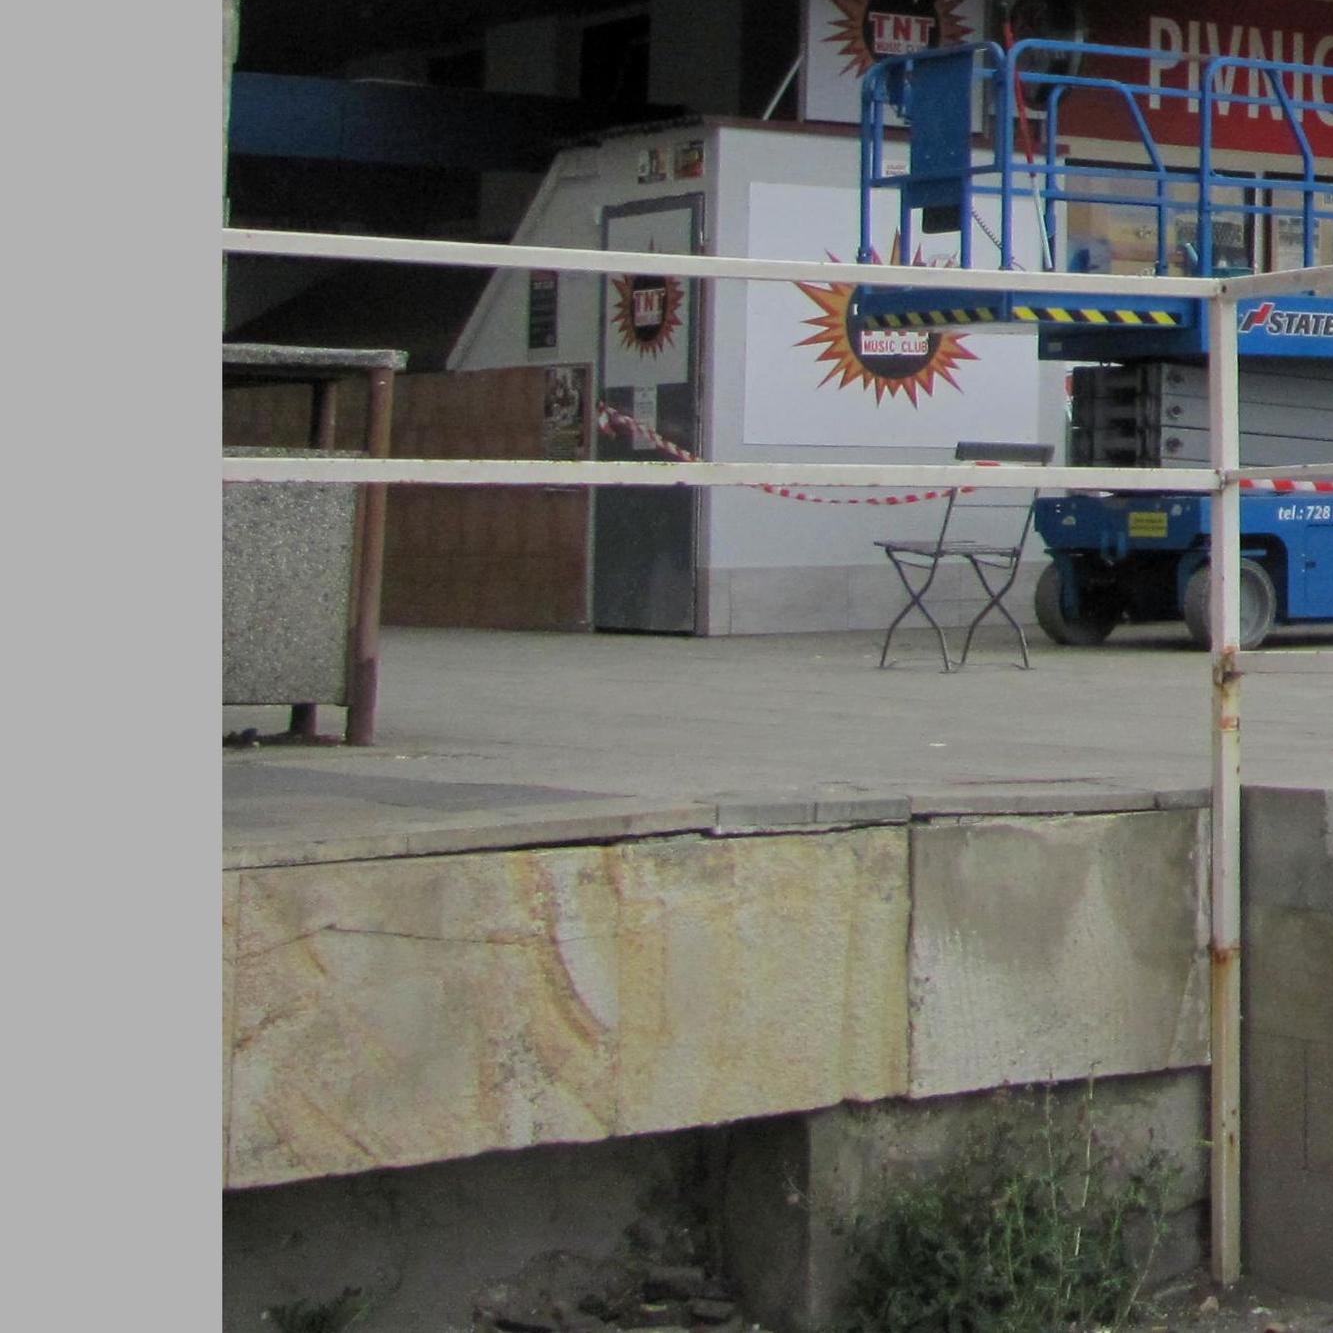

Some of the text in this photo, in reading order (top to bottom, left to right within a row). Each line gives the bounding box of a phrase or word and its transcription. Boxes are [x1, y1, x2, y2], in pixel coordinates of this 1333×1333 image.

[871, 15, 933, 43] TNT
[633, 290, 665, 314] TNT
[864, 340, 928, 353] MUSIC CLUB
[1305, 506, 1331, 521] 728
